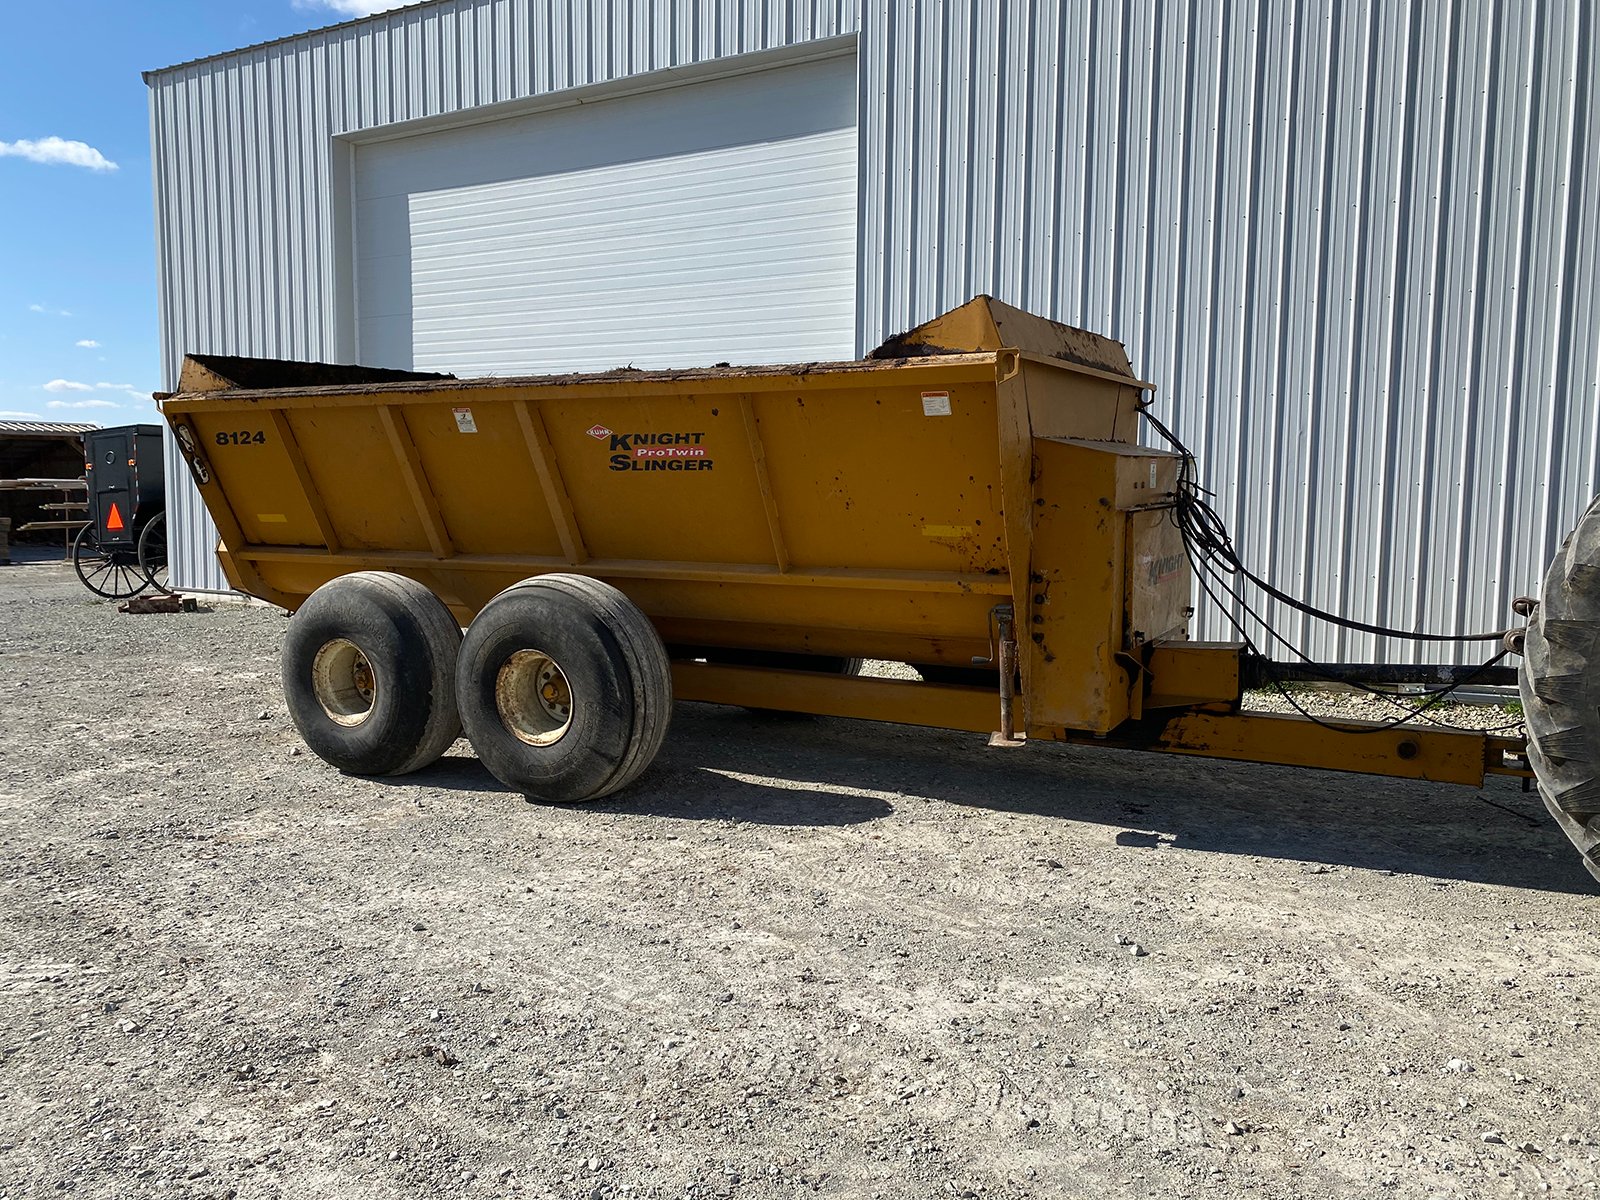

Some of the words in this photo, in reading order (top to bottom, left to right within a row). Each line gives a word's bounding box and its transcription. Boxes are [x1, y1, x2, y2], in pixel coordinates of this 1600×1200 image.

[215, 431, 266, 445] 8124
[609, 432, 705, 451] KNIGHT
[637, 447, 704, 456] ProTwin
[608, 454, 713, 471] SLINGER
